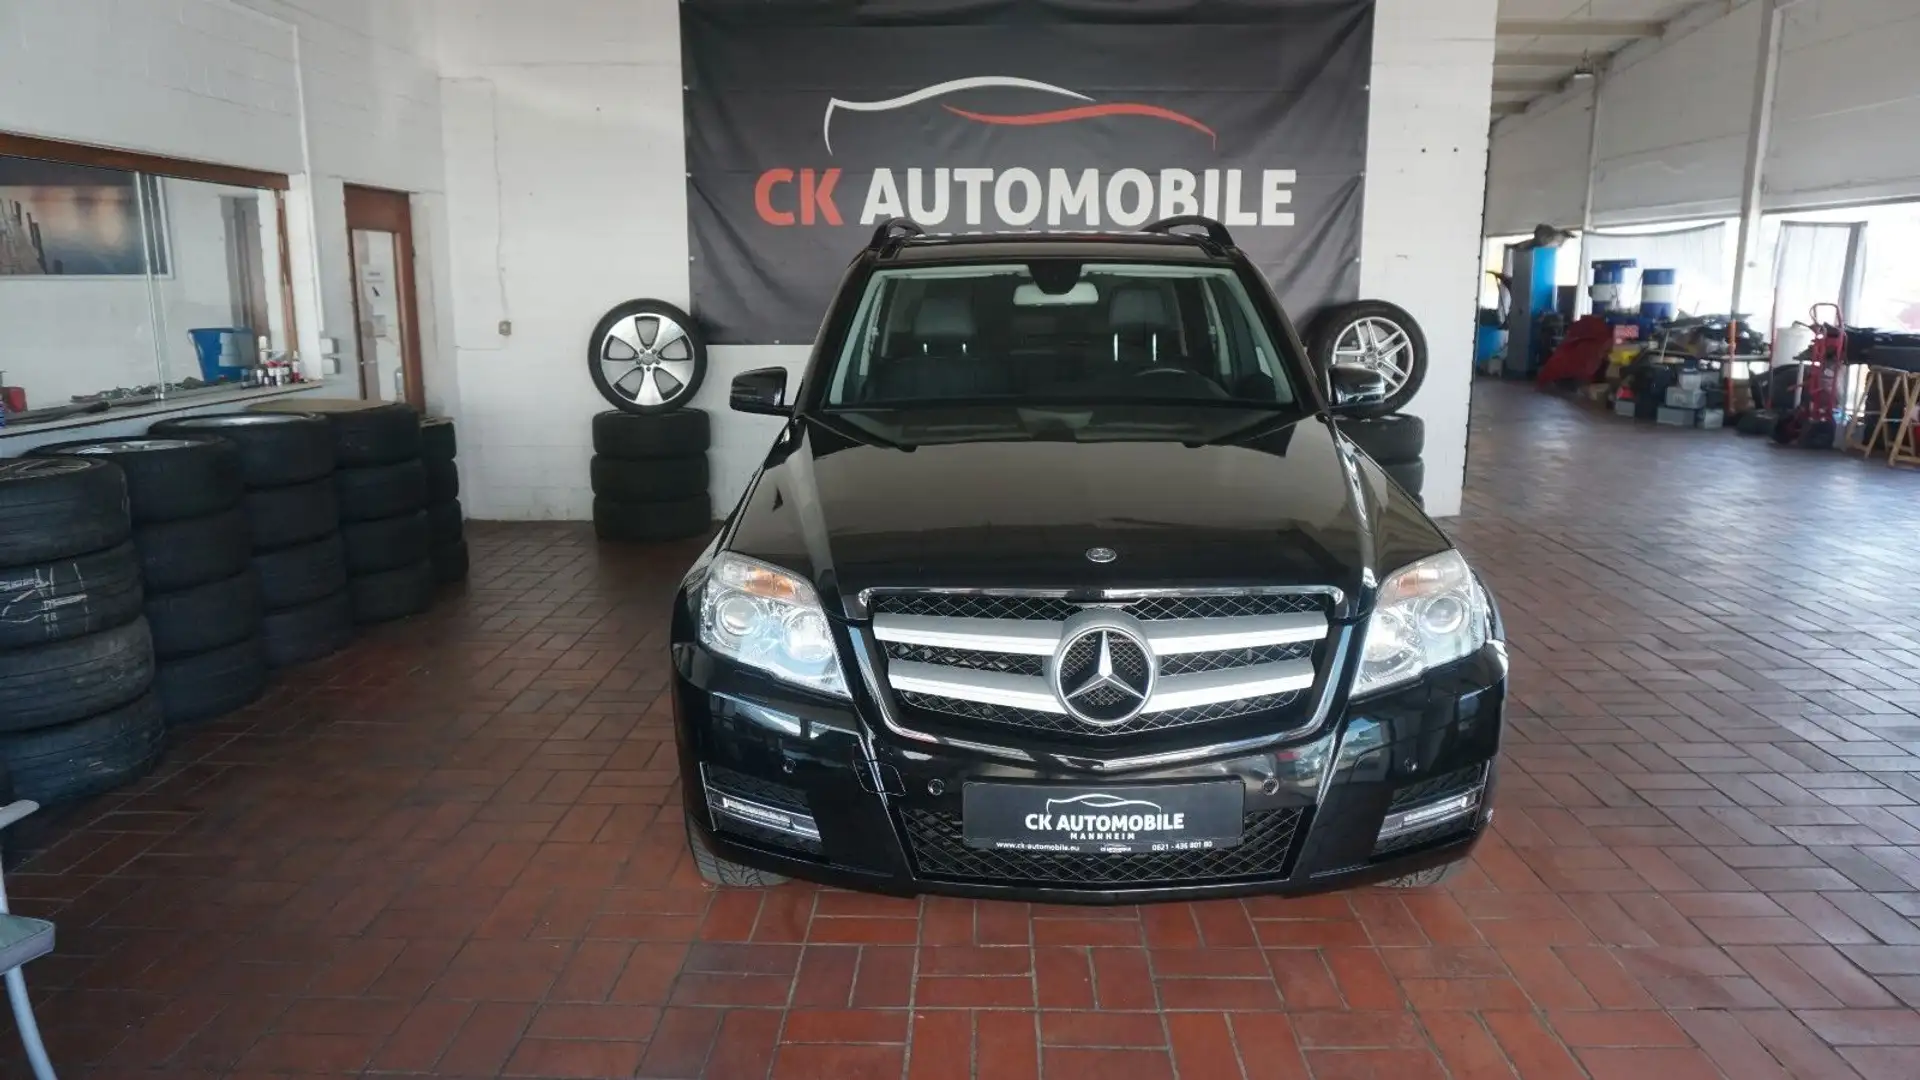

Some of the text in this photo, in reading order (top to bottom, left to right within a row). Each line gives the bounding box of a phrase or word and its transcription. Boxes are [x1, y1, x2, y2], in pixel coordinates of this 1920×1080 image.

[754, 167, 1297, 227] CK AUTOMOBILE
[1025, 813, 1185, 832] CK AUTOMOBILE
[1070, 832, 1136, 840] MANNHEIM
[996, 842, 1080, 852] www.ck-automobile.eu
